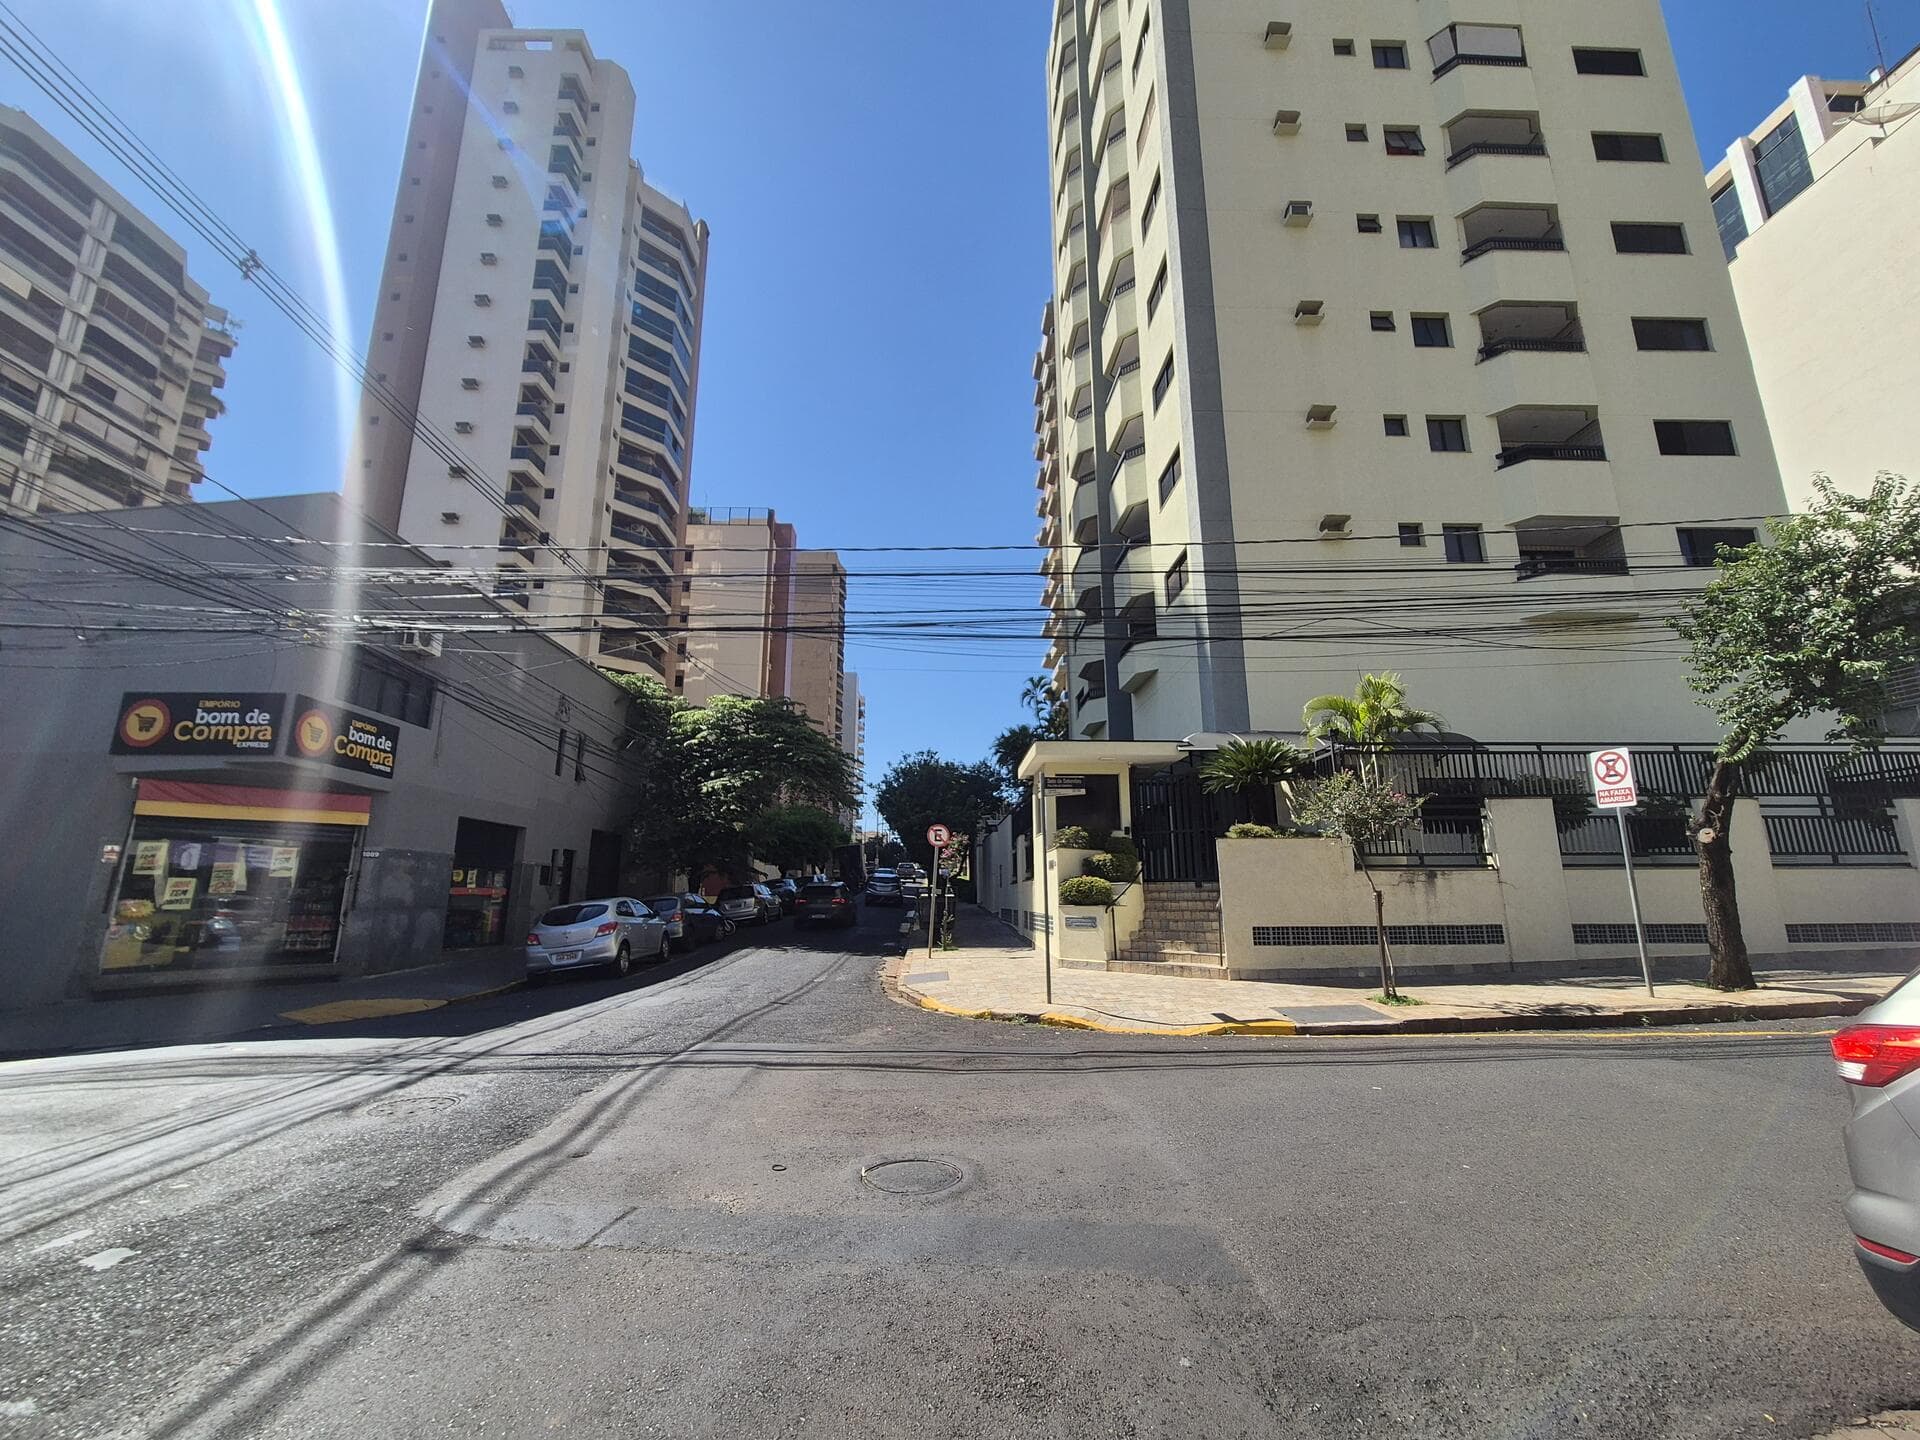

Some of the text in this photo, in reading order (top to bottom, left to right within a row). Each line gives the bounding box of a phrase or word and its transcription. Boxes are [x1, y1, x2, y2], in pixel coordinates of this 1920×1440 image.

[195, 709, 270, 724] bom de
[174, 721, 272, 745] Compra
[349, 726, 392, 751] bom de
[334, 735, 393, 766] Compra
[1610, 789, 1630, 797] FAIXA
